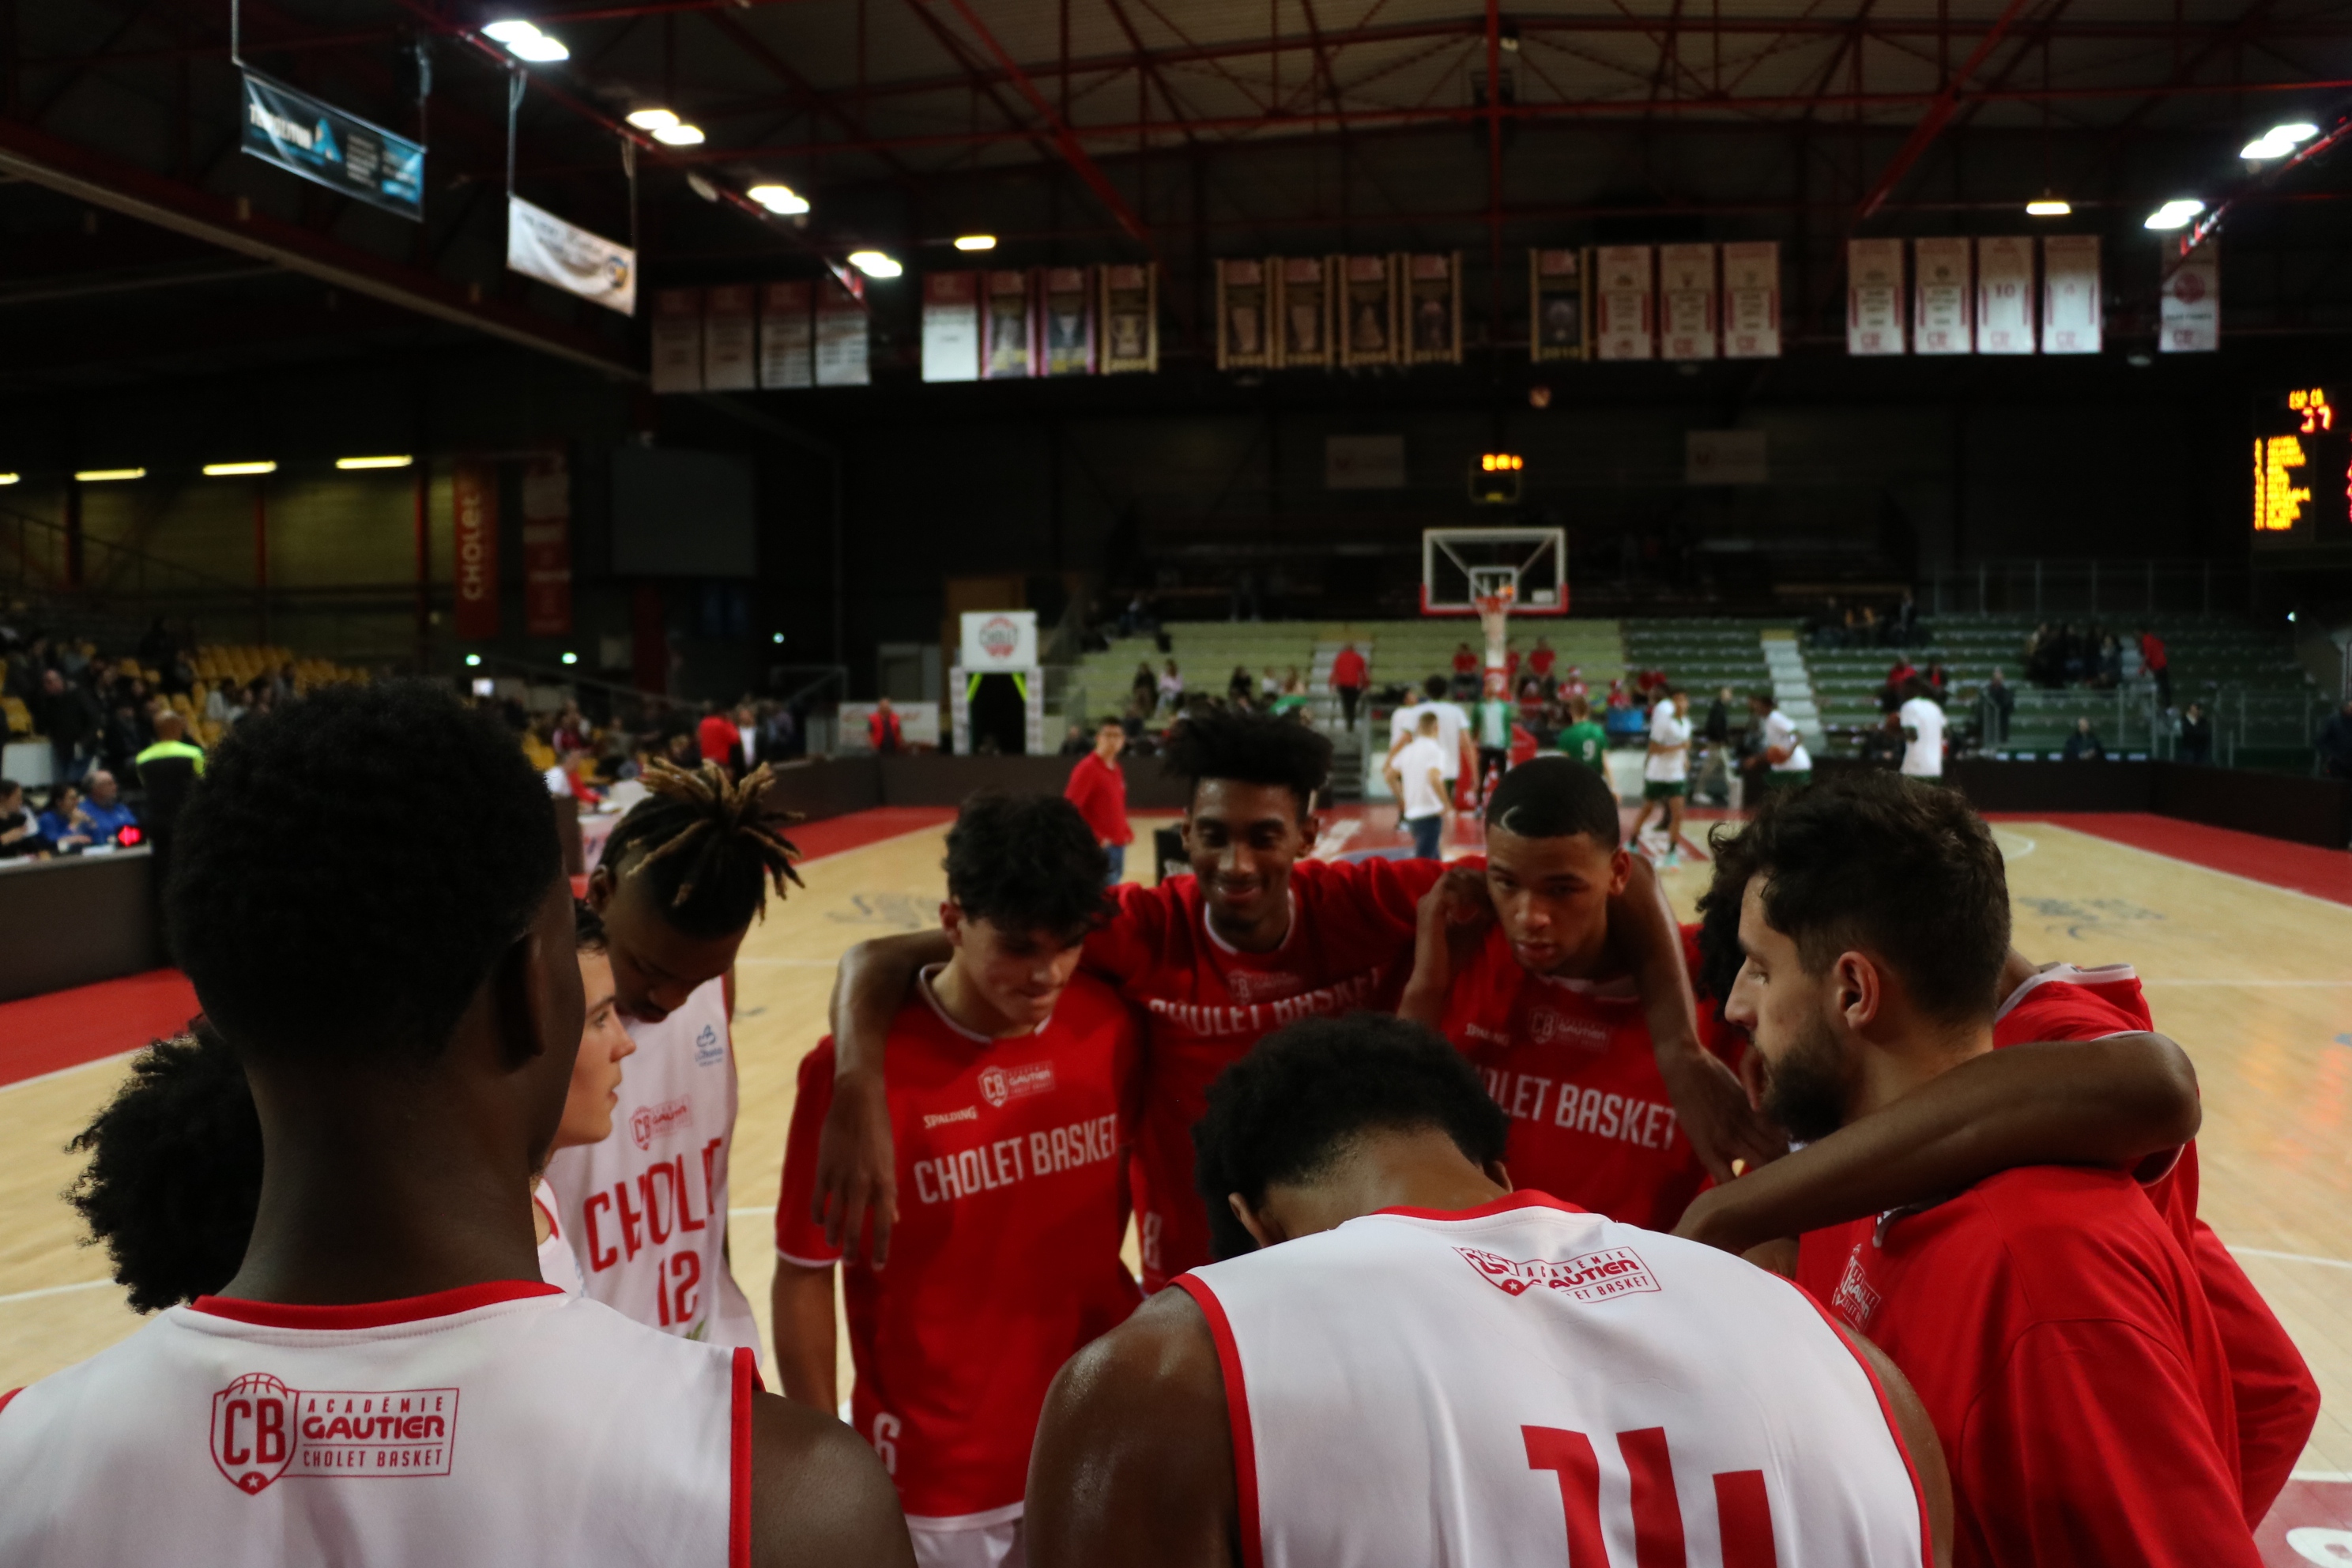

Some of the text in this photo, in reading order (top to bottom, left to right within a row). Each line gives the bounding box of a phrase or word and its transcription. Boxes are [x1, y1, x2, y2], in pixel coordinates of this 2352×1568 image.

[982, 1072, 1007, 1099] CB
[922, 1105, 978, 1130] SPALDING
[1554, 1081, 1676, 1151] BASKET
[913, 1113, 1118, 1204] CHOLET BASKET
[1143, 1210, 1163, 1271] 8
[1532, 1259, 1640, 1289] AUTIER
[1597, 1275, 1650, 1296] BASKET
[657, 1250, 701, 1328] 12
[307, 1396, 443, 1413] ACADÉMIE
[223, 1397, 286, 1465] CB
[302, 1415, 445, 1439] GAUTIER
[303, 1449, 443, 1468] CHOLET BASKET
